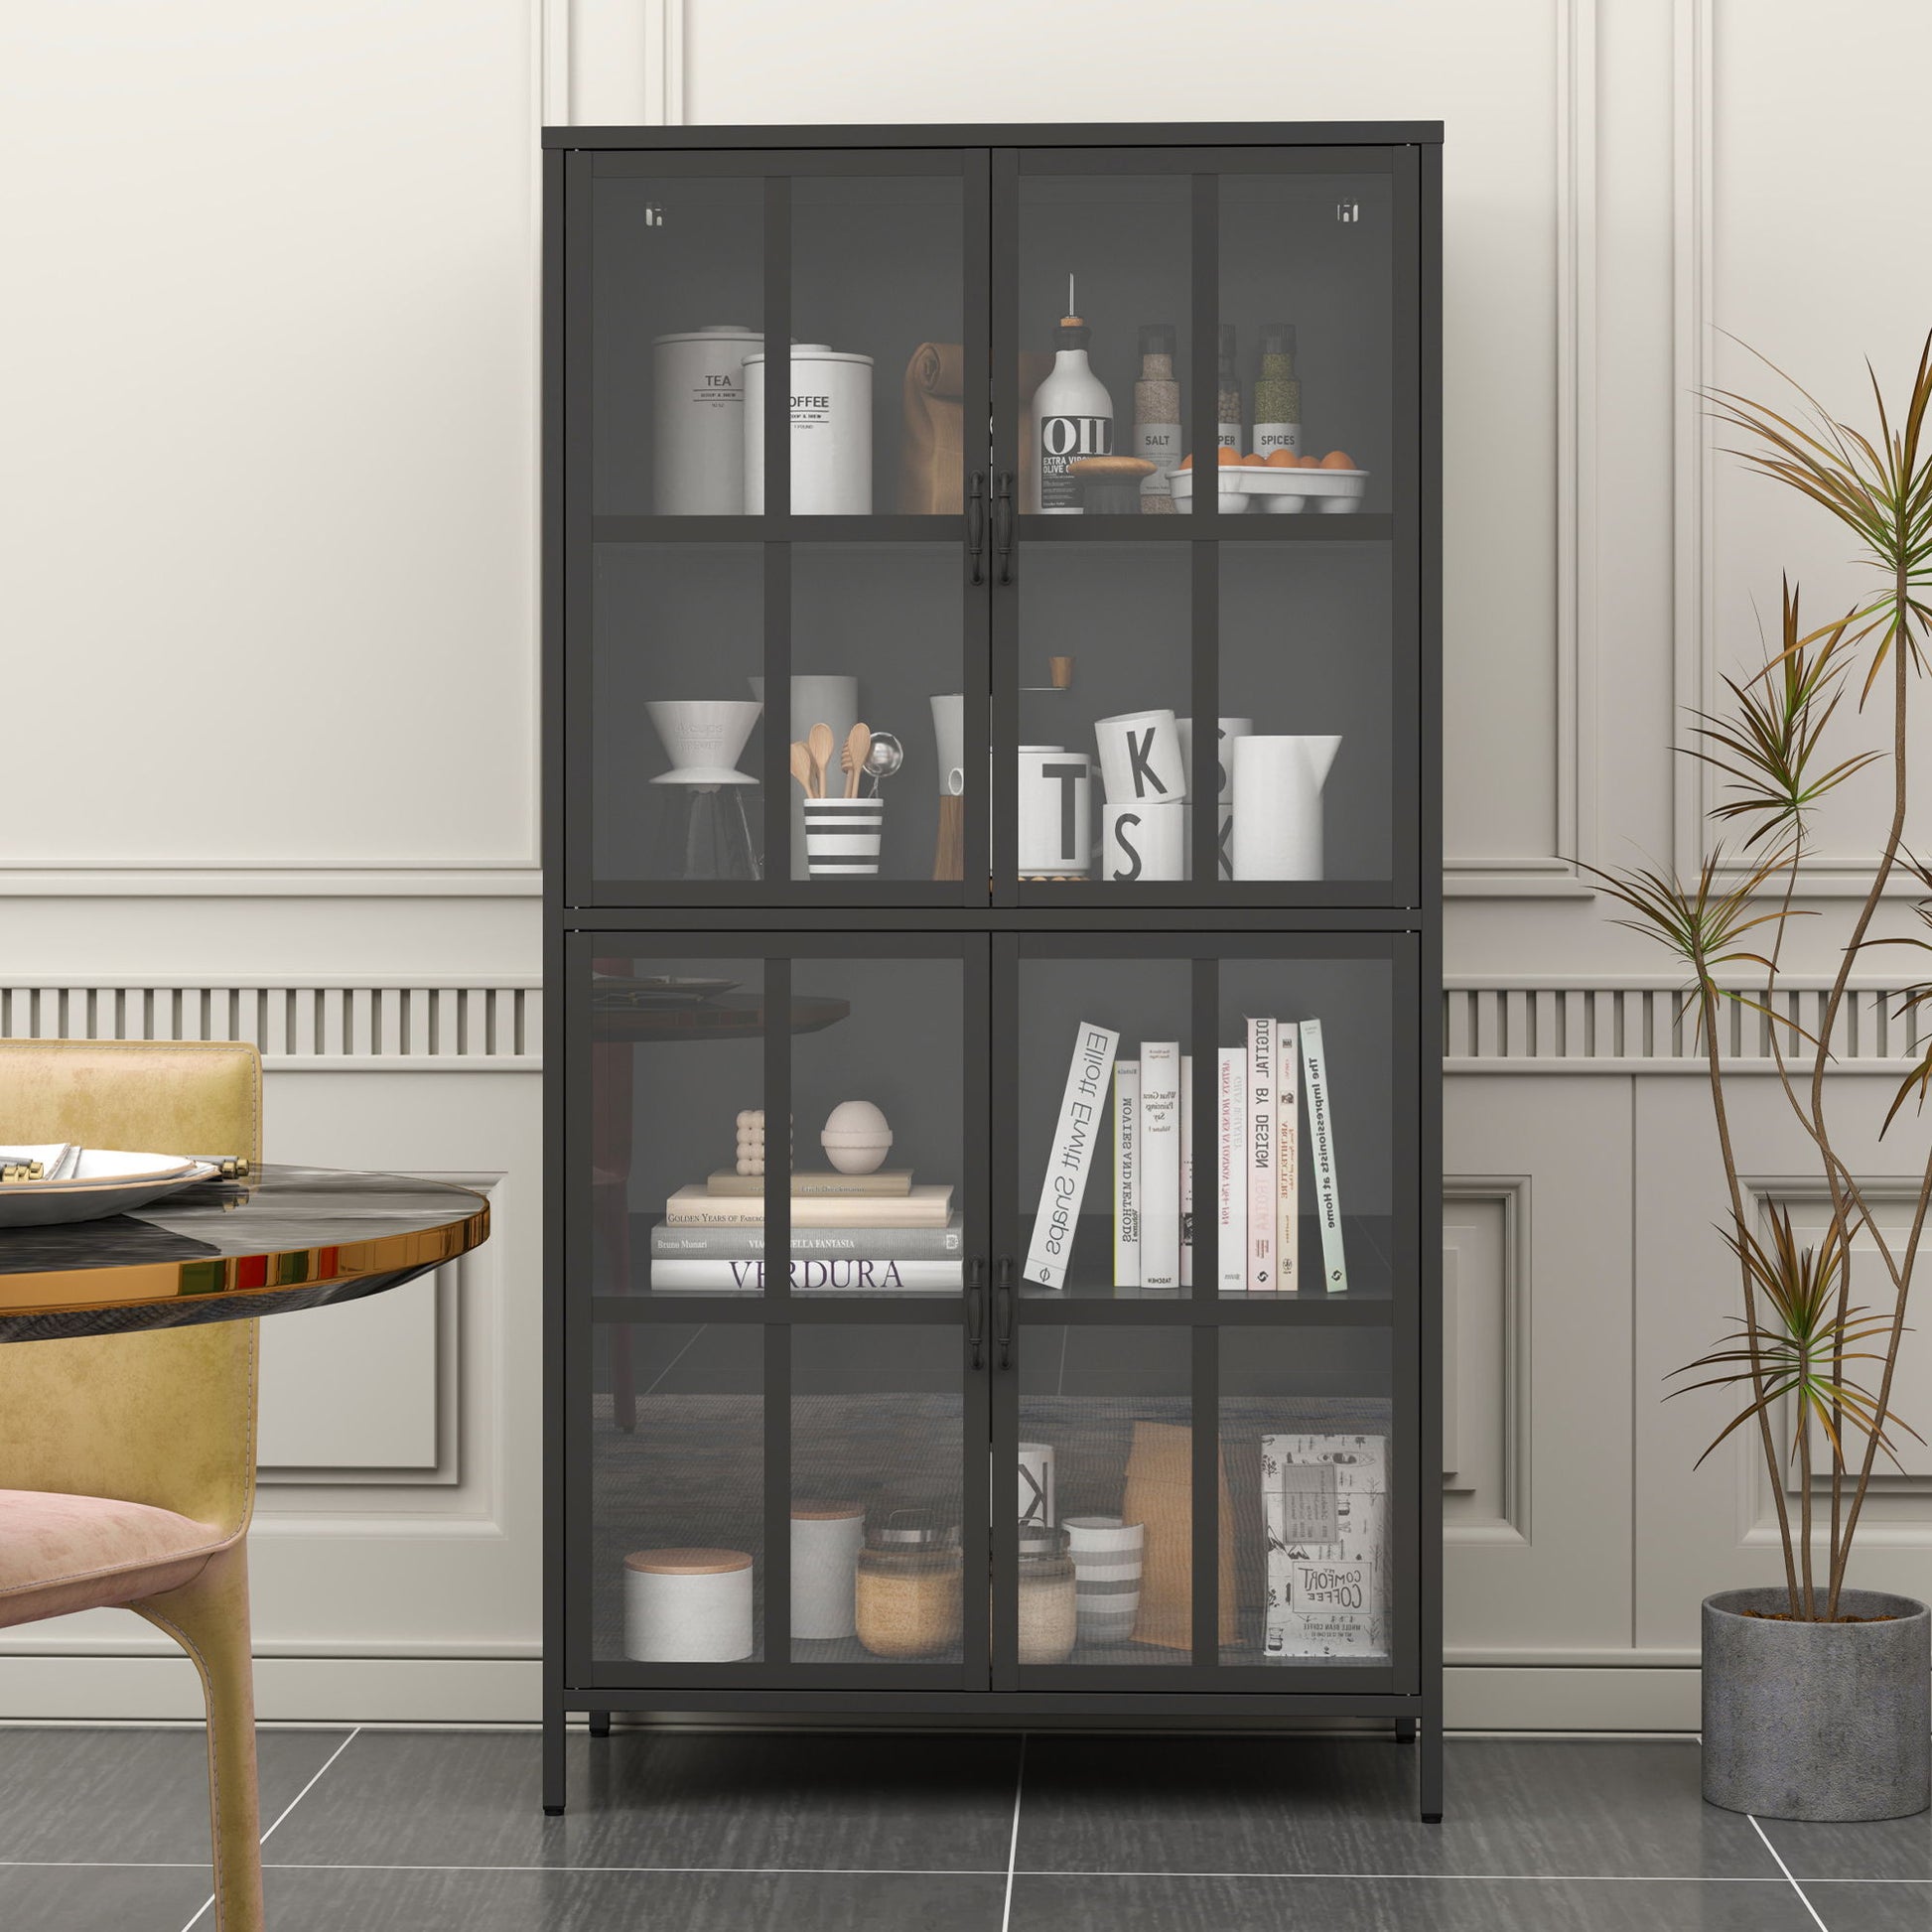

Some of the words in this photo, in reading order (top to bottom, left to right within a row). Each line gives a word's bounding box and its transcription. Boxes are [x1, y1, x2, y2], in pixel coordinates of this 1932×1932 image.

[705, 375, 732, 386] TEA
[790, 396, 829, 407] OFFEE
[1043, 417, 1112, 456] OIL
[1145, 435, 1170, 446] SALT
[1218, 435, 1236, 446] PER
[1261, 435, 1295, 446] SPICES
[1043, 457, 1066, 466] EXTRA
[1043, 465, 1063, 474] OLIVE
[1127, 727, 1168, 798] K
[1042, 763, 1087, 860] T
[1113, 813, 1142, 882] S
[668, 1213, 699, 1223] GOLDEN
[702, 1213, 726, 1223] YEARS
[657, 1239, 680, 1249] Bruno
[681, 1239, 708, 1249] Munari
[791, 1239, 814, 1248] ELLA
[815, 1239, 855, 1248] FANTASIA
